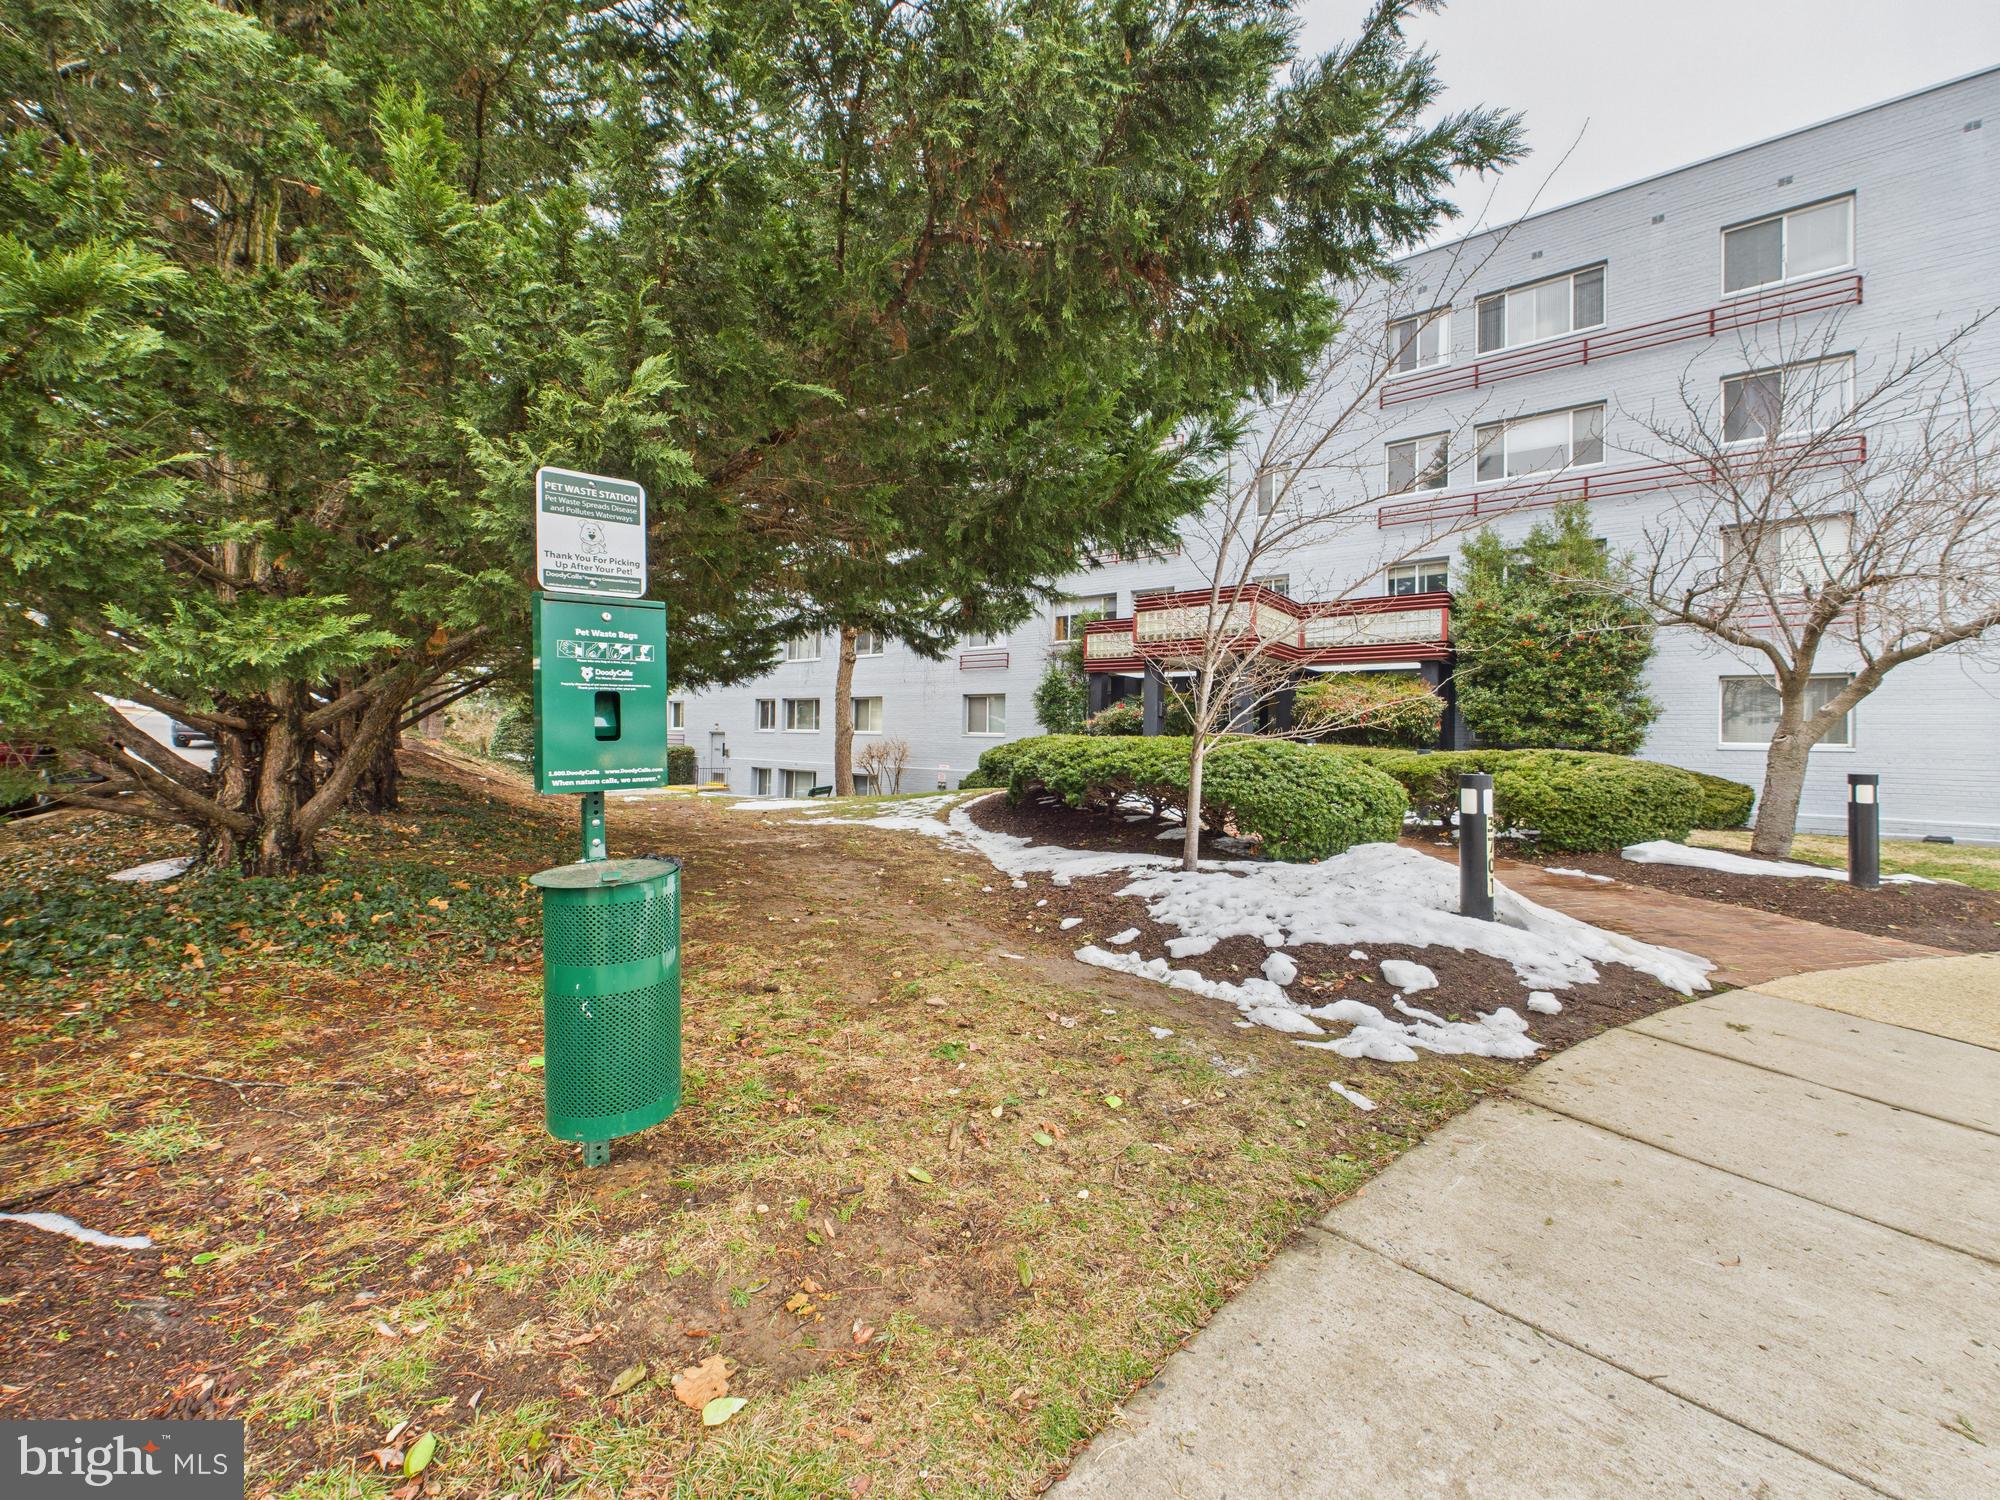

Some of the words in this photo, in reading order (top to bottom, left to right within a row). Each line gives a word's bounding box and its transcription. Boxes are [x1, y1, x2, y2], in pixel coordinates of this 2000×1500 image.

[544, 481, 563, 492] PET
[564, 484, 597, 498] WASTE
[599, 490, 638, 503] STATION
[545, 494, 558, 503] Pet
[558, 496, 581, 506] Waste
[582, 499, 610, 511] Spreads
[611, 504, 638, 515] Disease
[550, 504, 565, 512] and
[566, 506, 594, 518] Pollutes
[596, 511, 633, 523] Waterways
[544, 550, 573, 561] Thank
[574, 554, 591, 563] You
[593, 556, 607, 564] For
[609, 557, 641, 569] Picking
[555, 561, 569, 570] Up
[570, 562, 593, 572] After
[594, 565, 615, 574] Your
[616, 567, 633, 576] Pet!
[575, 628, 590, 637] Pet
[591, 629, 617, 638] Waste
[618, 631, 638, 640] Bags
[595, 668, 633, 677] DoodyCalls
[605, 767, 664, 775] www.DoodyCalls.com
[575, 778, 600, 786] nature
[601, 777, 620, 785] calls,
